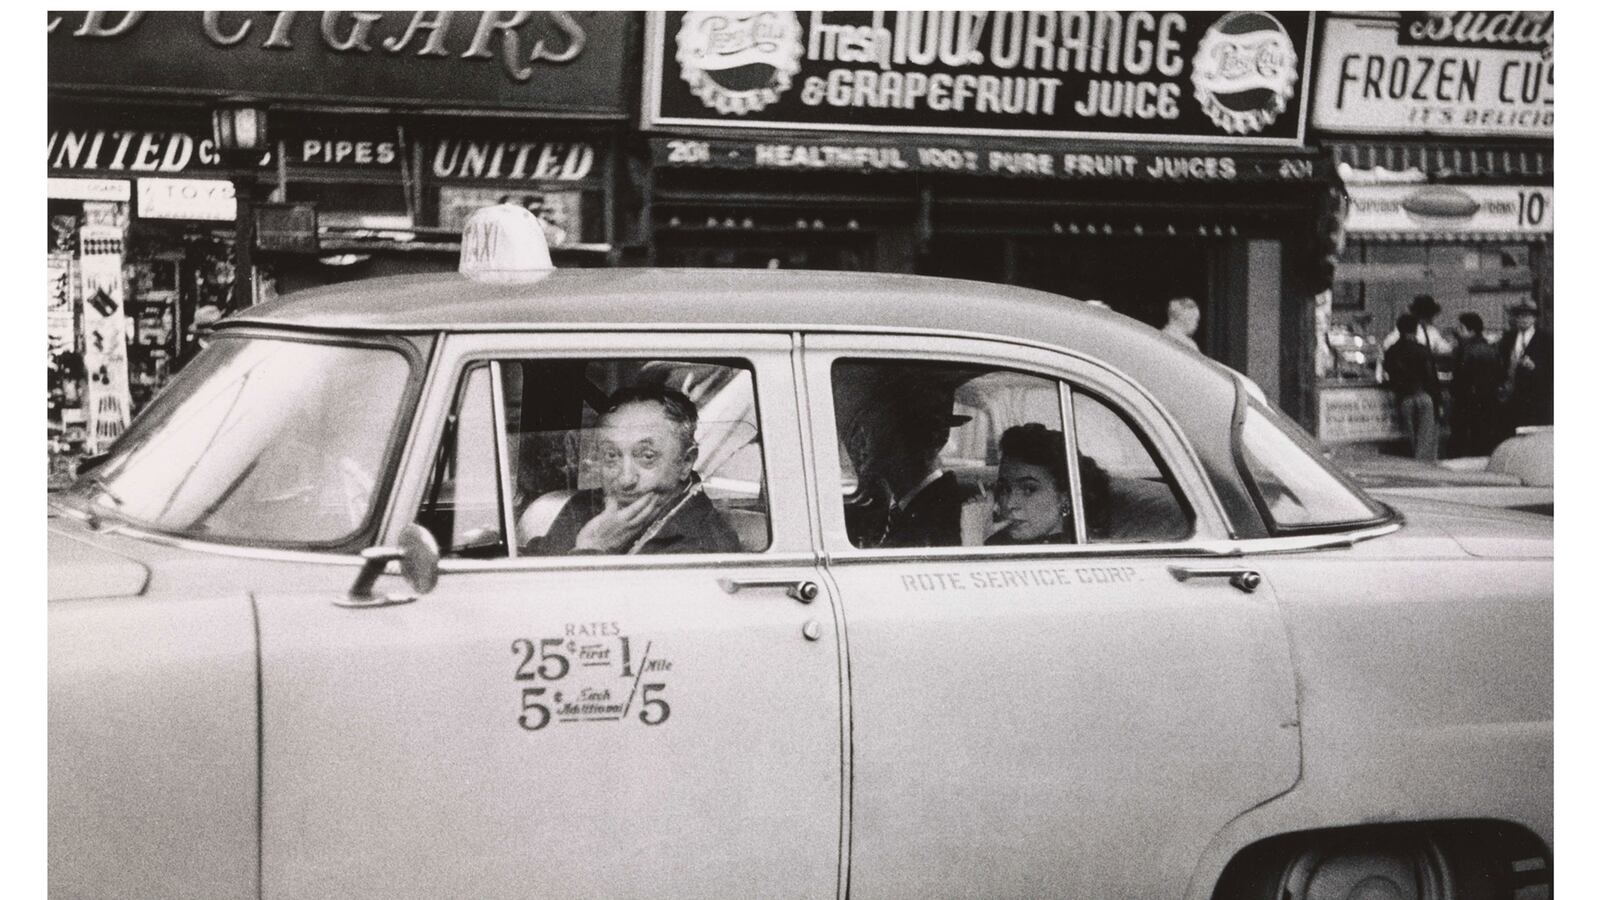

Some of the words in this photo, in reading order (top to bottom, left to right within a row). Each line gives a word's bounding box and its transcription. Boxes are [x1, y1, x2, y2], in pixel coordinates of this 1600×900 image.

[990, 11, 1188, 77] ORANGE
[1074, 80, 1182, 120] JUICE
[1336, 53, 1480, 110] FROZEN
[303, 140, 396, 164] PIPES
[432, 140, 595, 181] UNITED
[755, 144, 909, 169] HEALTHFUL
[988, 151, 1054, 175] PURE
[1063, 154, 1138, 177] FRUIT
[1146, 156, 1237, 179] JUICES
[971, 568, 1072, 589] SERVICE
[565, 622, 620, 637] RATES
